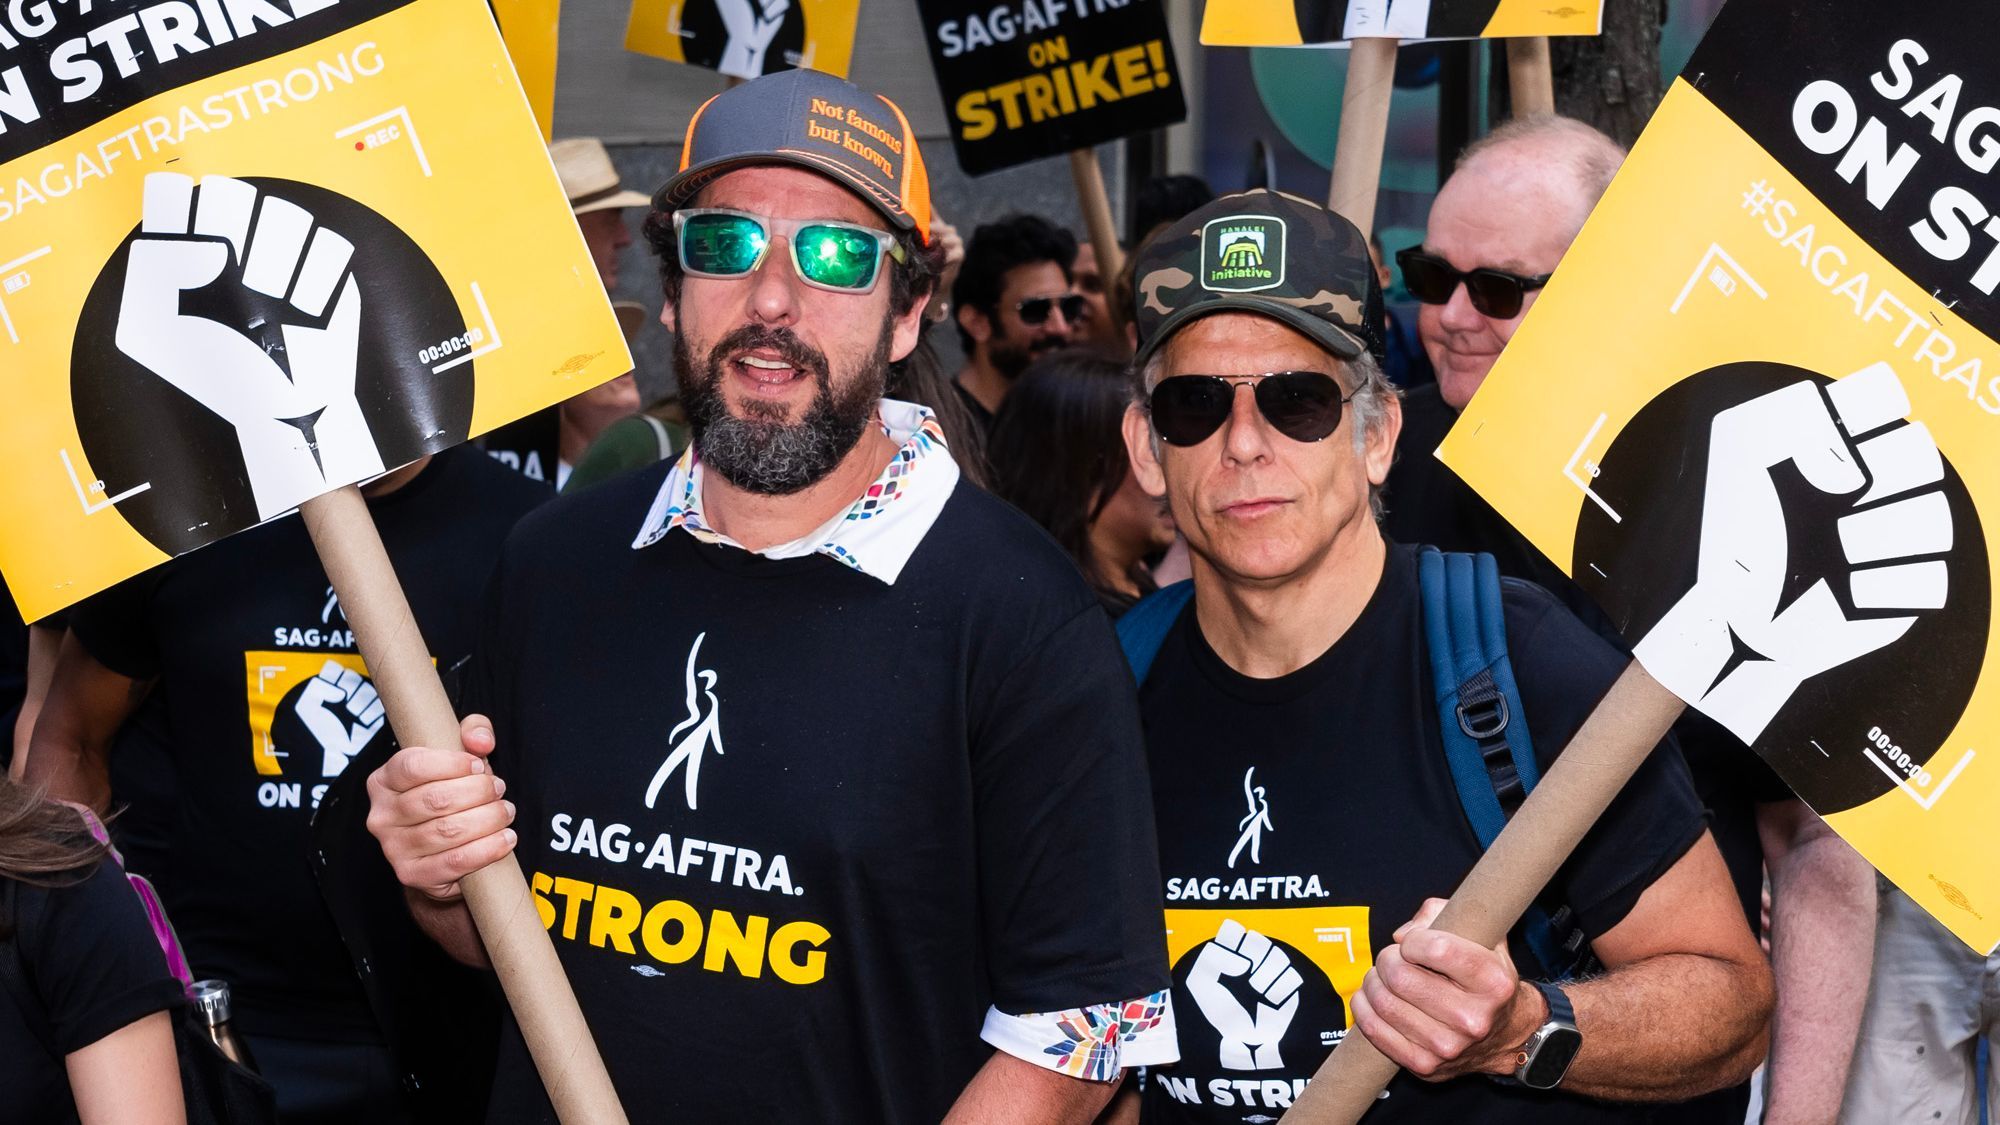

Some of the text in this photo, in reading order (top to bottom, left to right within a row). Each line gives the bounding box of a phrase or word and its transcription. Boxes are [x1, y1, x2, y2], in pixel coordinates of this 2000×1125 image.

[1028, 35, 1070, 68] ON
[956, 39, 1171, 141] STRIKE!
[365, 125, 400, 149] REC
[808, 119, 841, 144] but
[811, 98, 902, 154] Not famous
[1792, 79, 1922, 211] ON
[1220, 225, 1265, 234] HANALEI
[1211, 267, 1272, 281] initiative
[418, 327, 484, 365] 00:00:00
[1867, 725, 1932, 788] 00:00:00
[258, 781, 302, 809] ON
[531, 871, 832, 985] STRONG
